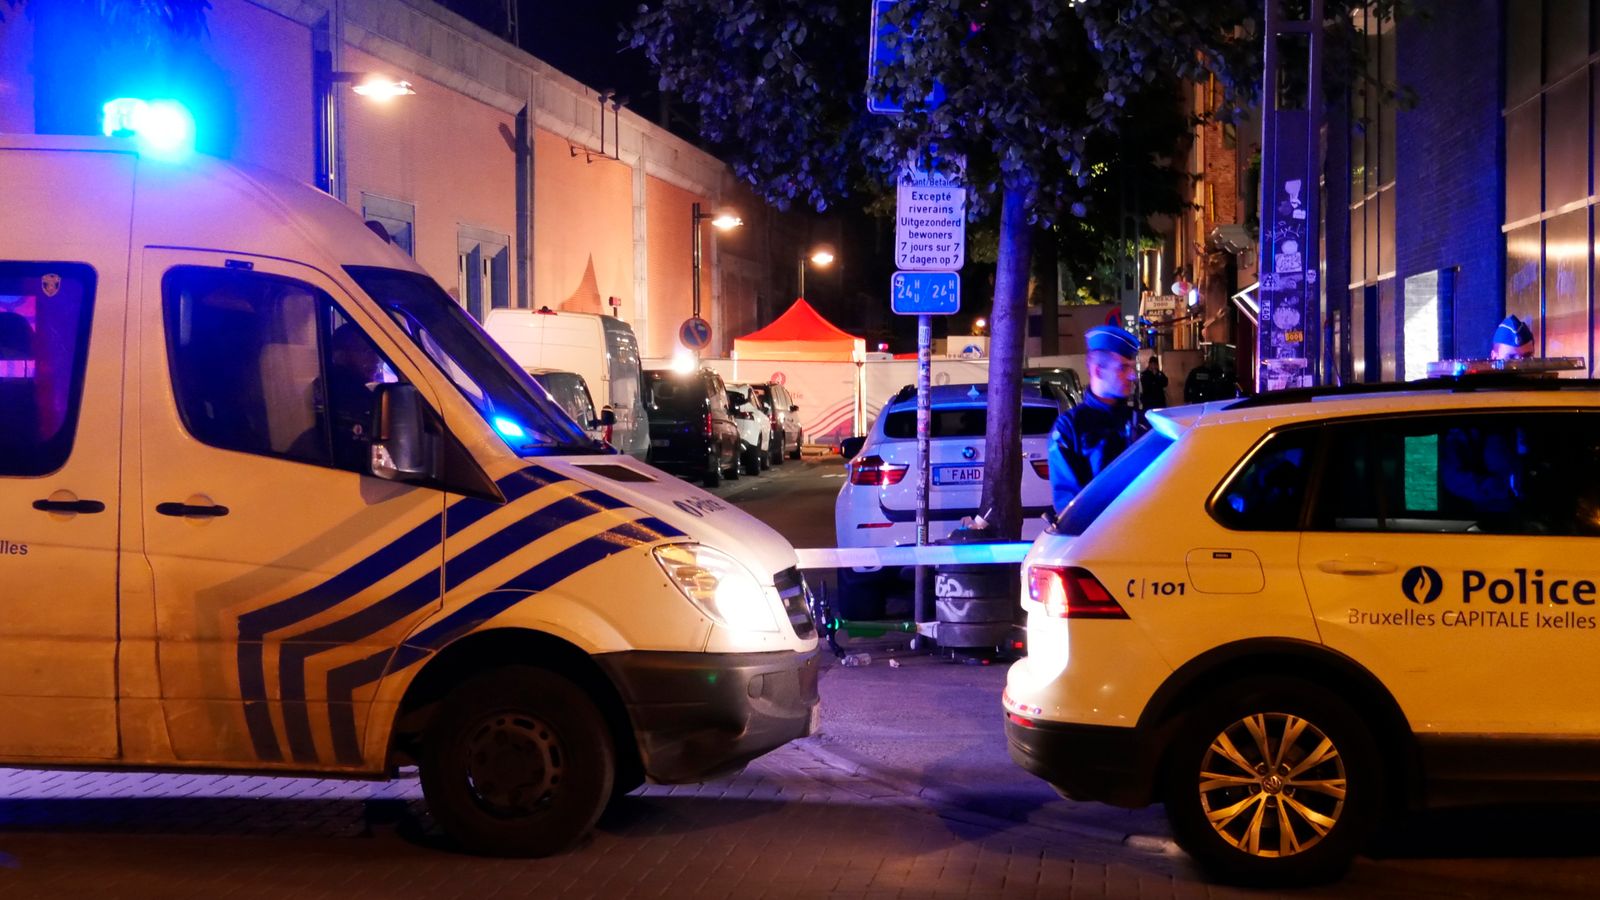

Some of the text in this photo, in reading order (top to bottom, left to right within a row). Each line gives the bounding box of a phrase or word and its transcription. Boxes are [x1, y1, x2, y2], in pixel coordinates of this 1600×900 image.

[911, 191, 952, 203] Excepté
[908, 205, 954, 214] riverains
[901, 217, 961, 229] Uitgezonderd
[908, 230, 953, 240] bewoners
[901, 241, 960, 253] 7 jours sur 7
[901, 254, 960, 267] 7 dagen op 7
[914, 279, 955, 290] H H
[914, 293, 955, 304] U U
[951, 469, 981, 480] FAHD
[0, 539, 28, 555] lles
[1151, 582, 1185, 596] 101
[1462, 568, 1597, 605] Police
[1348, 608, 1597, 629] Bruxelles CAPITALE Ixelles
